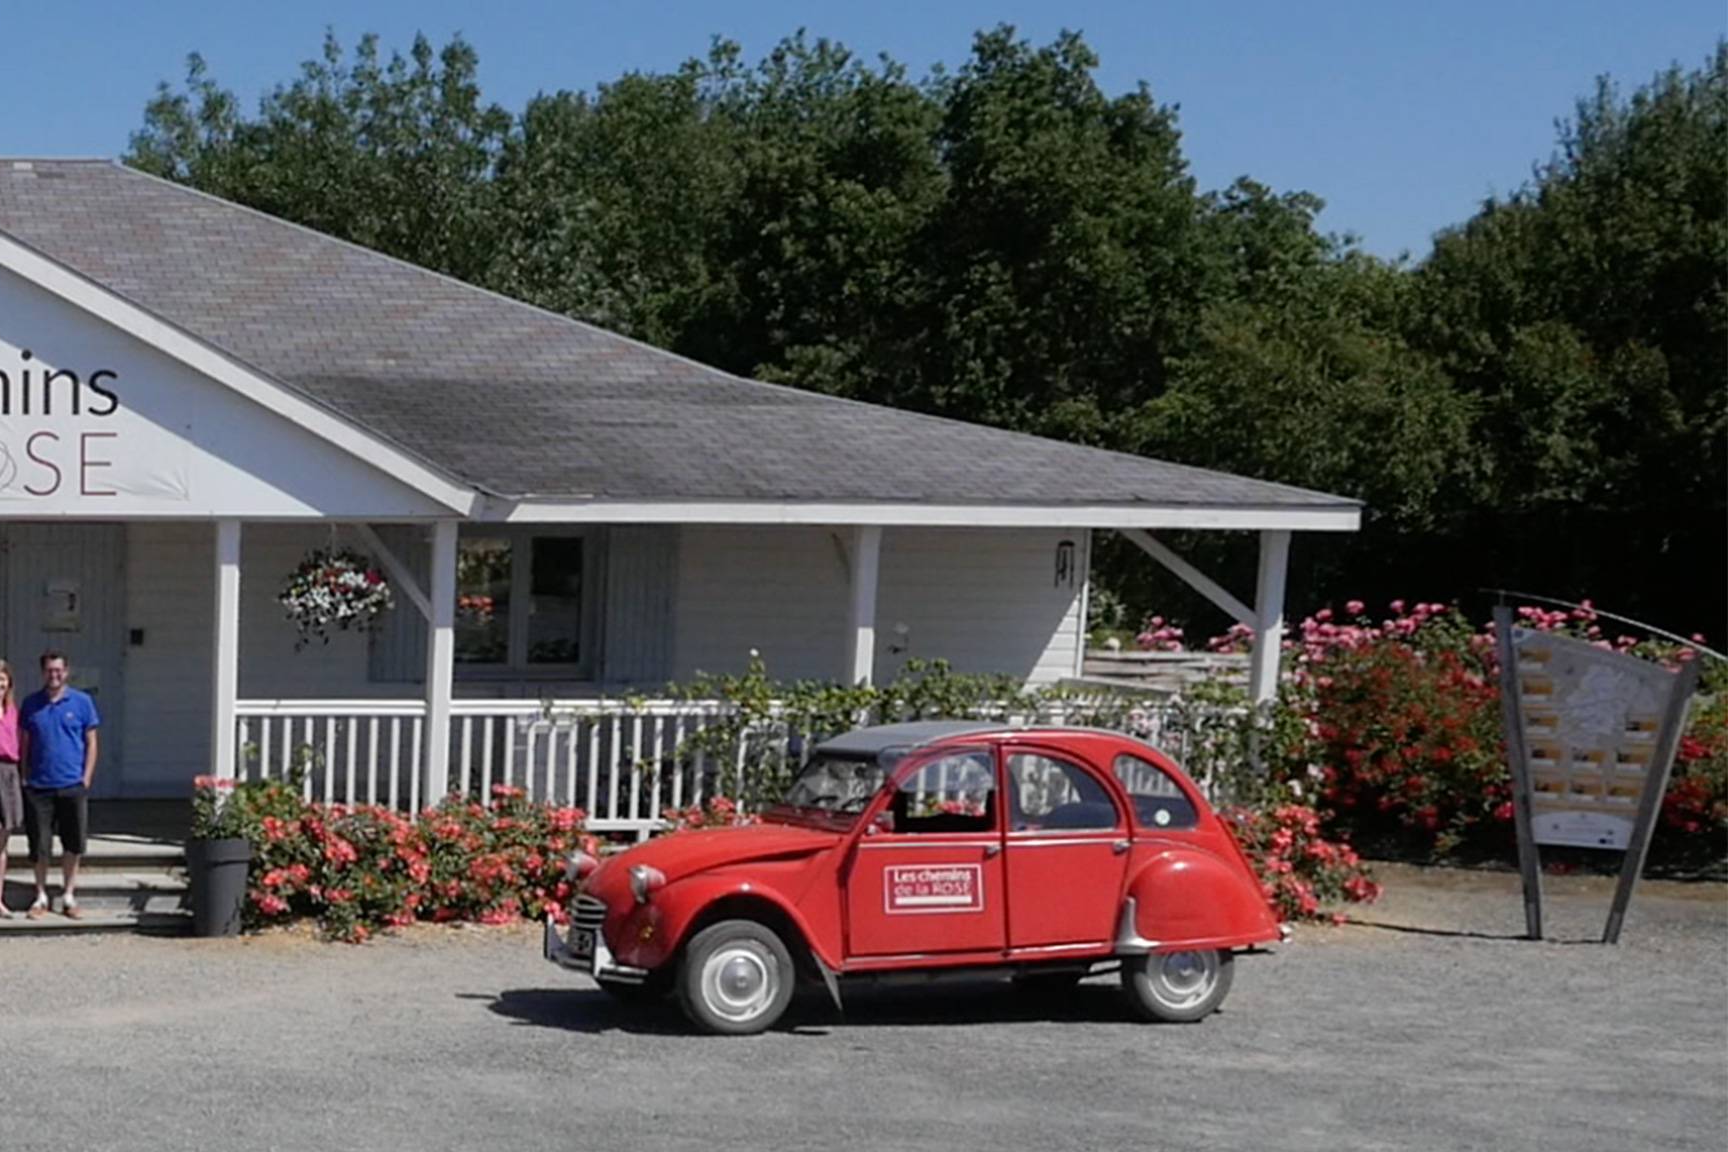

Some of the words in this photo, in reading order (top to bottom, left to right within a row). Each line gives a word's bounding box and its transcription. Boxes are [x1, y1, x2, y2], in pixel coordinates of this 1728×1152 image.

[894, 869, 915, 883] Les
[894, 884, 913, 896] de
[915, 884, 929, 895] la
[932, 882, 971, 896] ROSE
